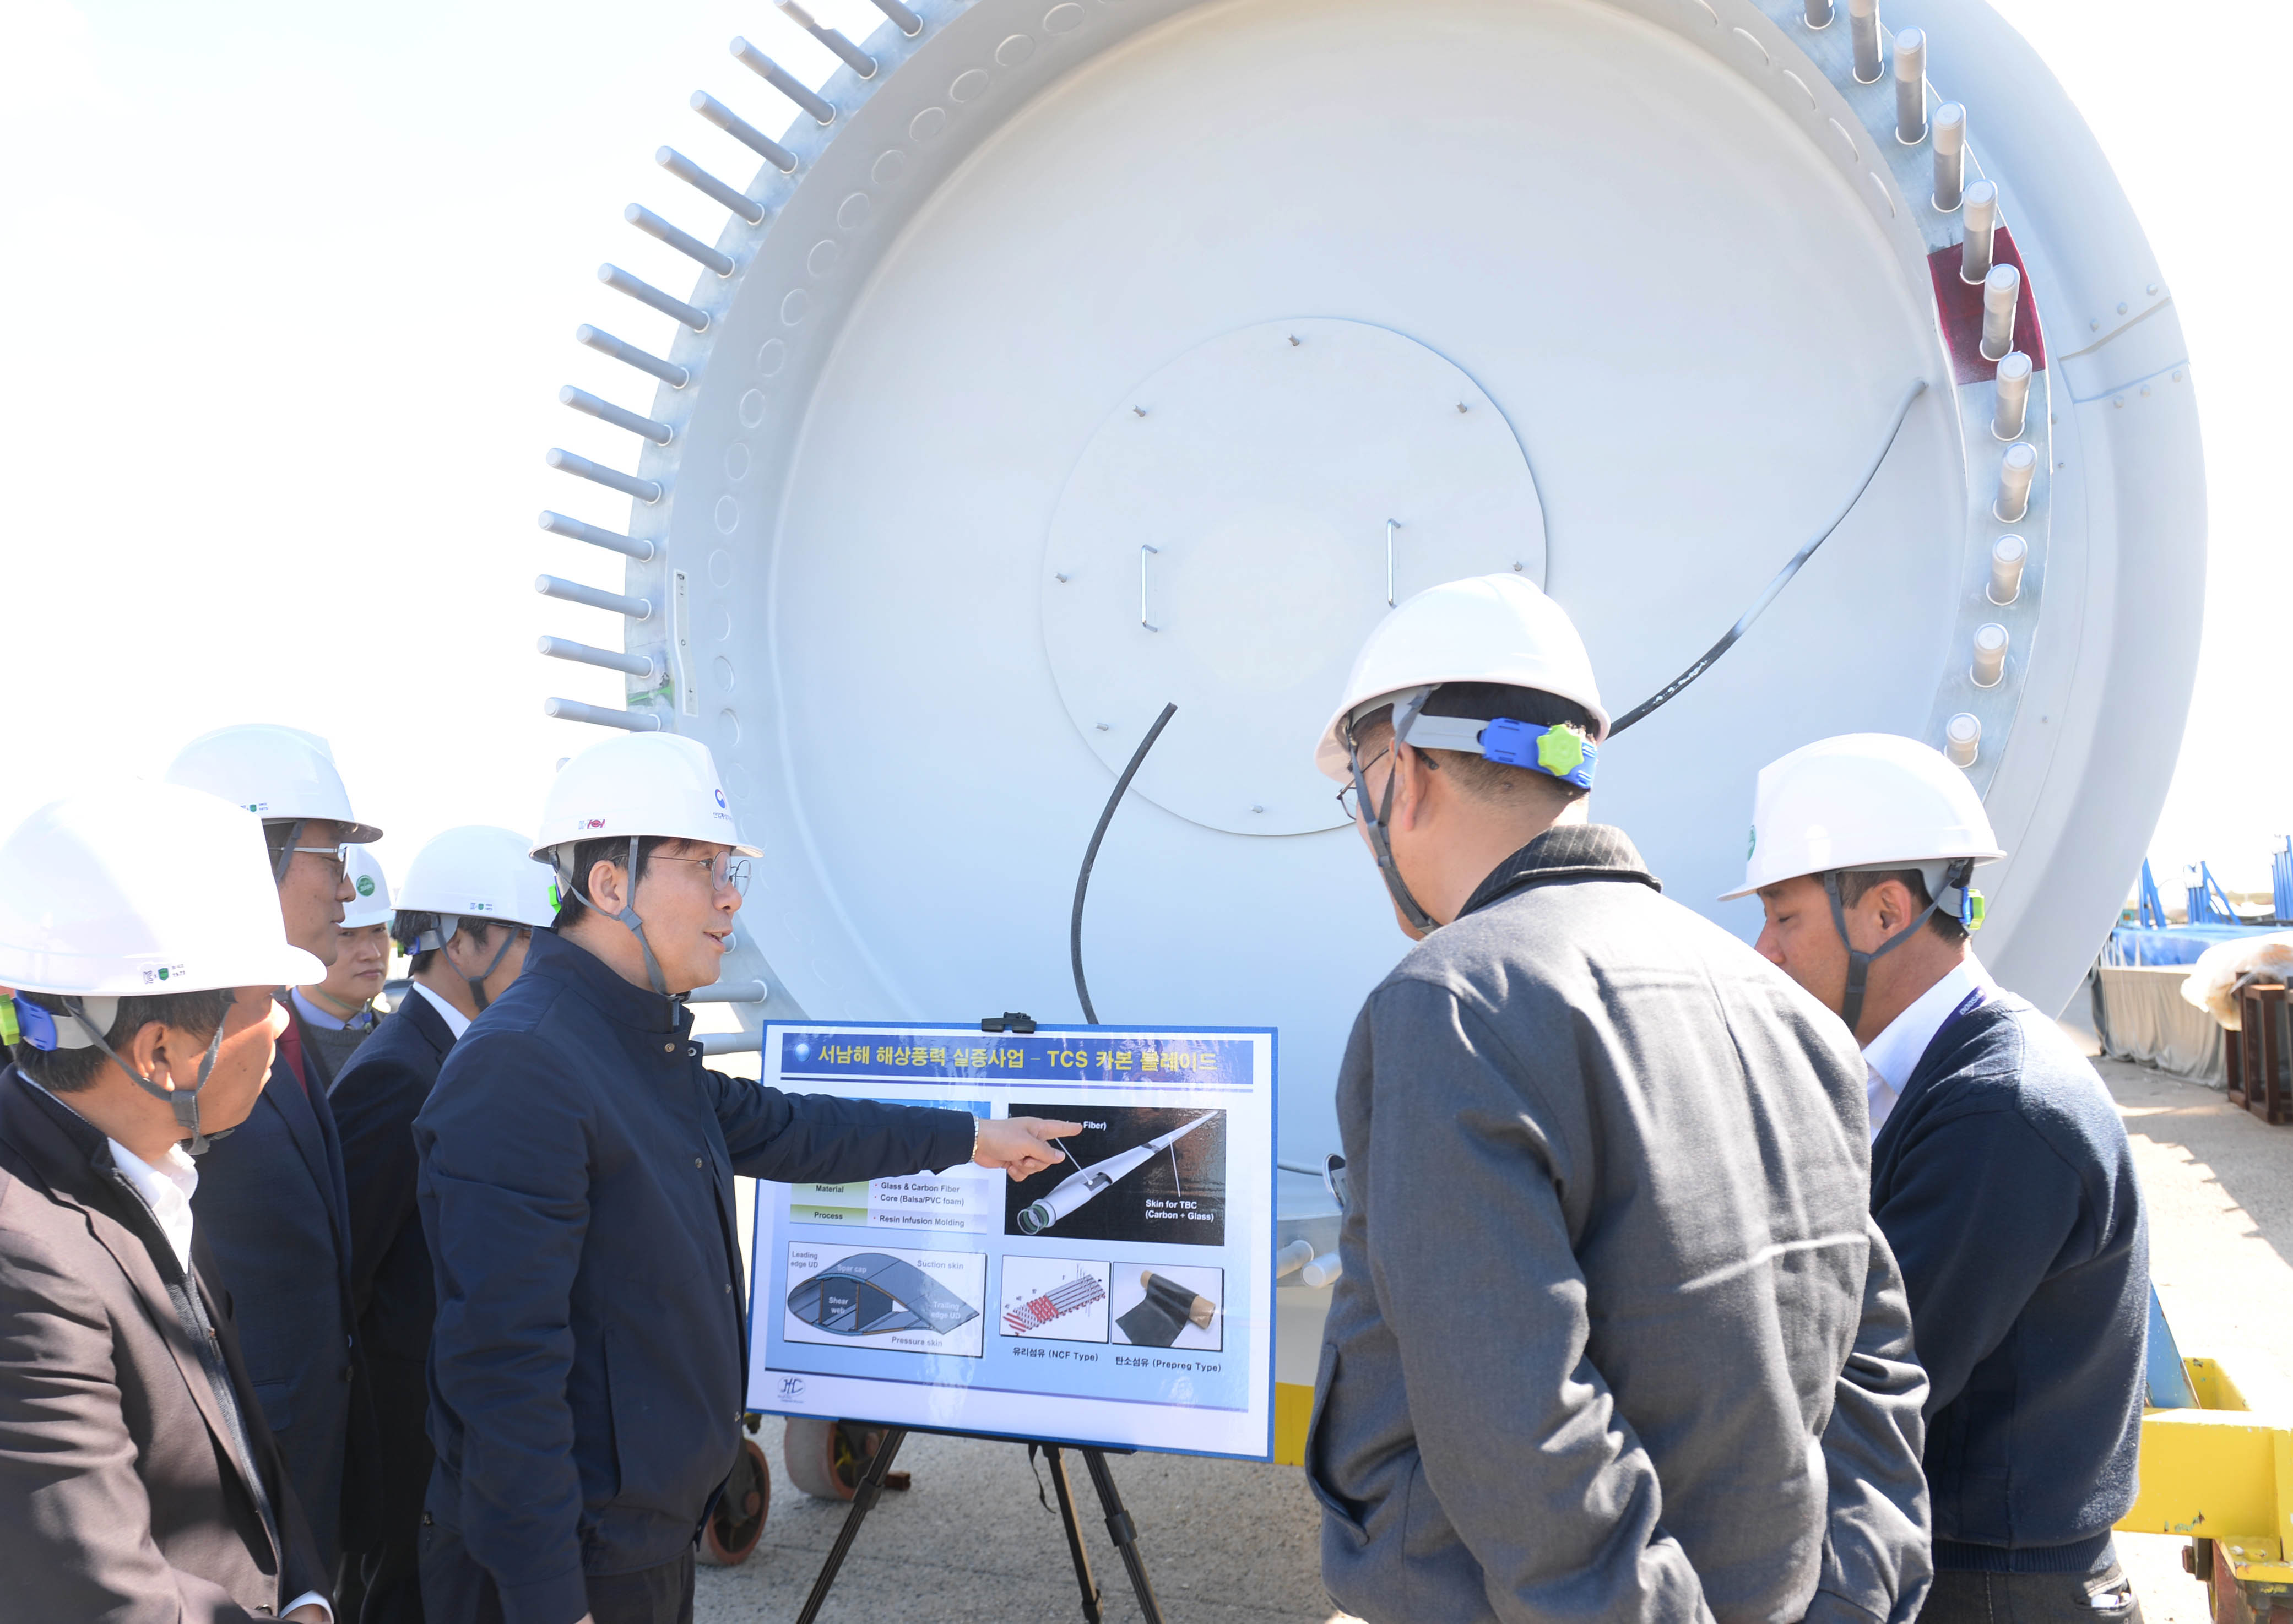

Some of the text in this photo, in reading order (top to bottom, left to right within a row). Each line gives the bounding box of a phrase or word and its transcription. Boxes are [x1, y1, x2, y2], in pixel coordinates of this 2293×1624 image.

[818, 1045, 870, 1064] 서남해
[876, 1047, 945, 1066] 해상풍력
[953, 1049, 1024, 1068] 실증사업
[1047, 1050, 1088, 1068] TCS
[1096, 1051, 1134, 1071] 카본
[1140, 1052, 1218, 1072] 블레이드
[1083, 1121, 1107, 1131] Fiber)
[816, 1185, 844, 1193] Material
[911, 1183, 938, 1192] Carbon
[940, 1185, 960, 1193] Fiber
[880, 1194, 964, 1206] Core (Balsa/PVC foam)
[1145, 1199, 1197, 1209] Skin for TBC
[814, 1211, 843, 1220] Process
[1145, 1210, 1178, 1220] (Carbon
[1187, 1212, 1214, 1223] Glass)
[880, 1215, 964, 1228] Resin Infusion Molding
[792, 1251, 818, 1260] Leading
[790, 1261, 806, 1269] edge
[917, 1259, 946, 1268] Suction
[837, 1265, 853, 1274] Spar
[828, 1297, 849, 1305] Shear
[934, 1302, 960, 1311] Trailing
[931, 1311, 948, 1320] edge
[891, 1336, 925, 1346] Pressure
[1013, 1347, 1098, 1362] 유리섬유 (NCF Type)
[1115, 1356, 1222, 1372] 탄소섬유 (Prepreg Type)
